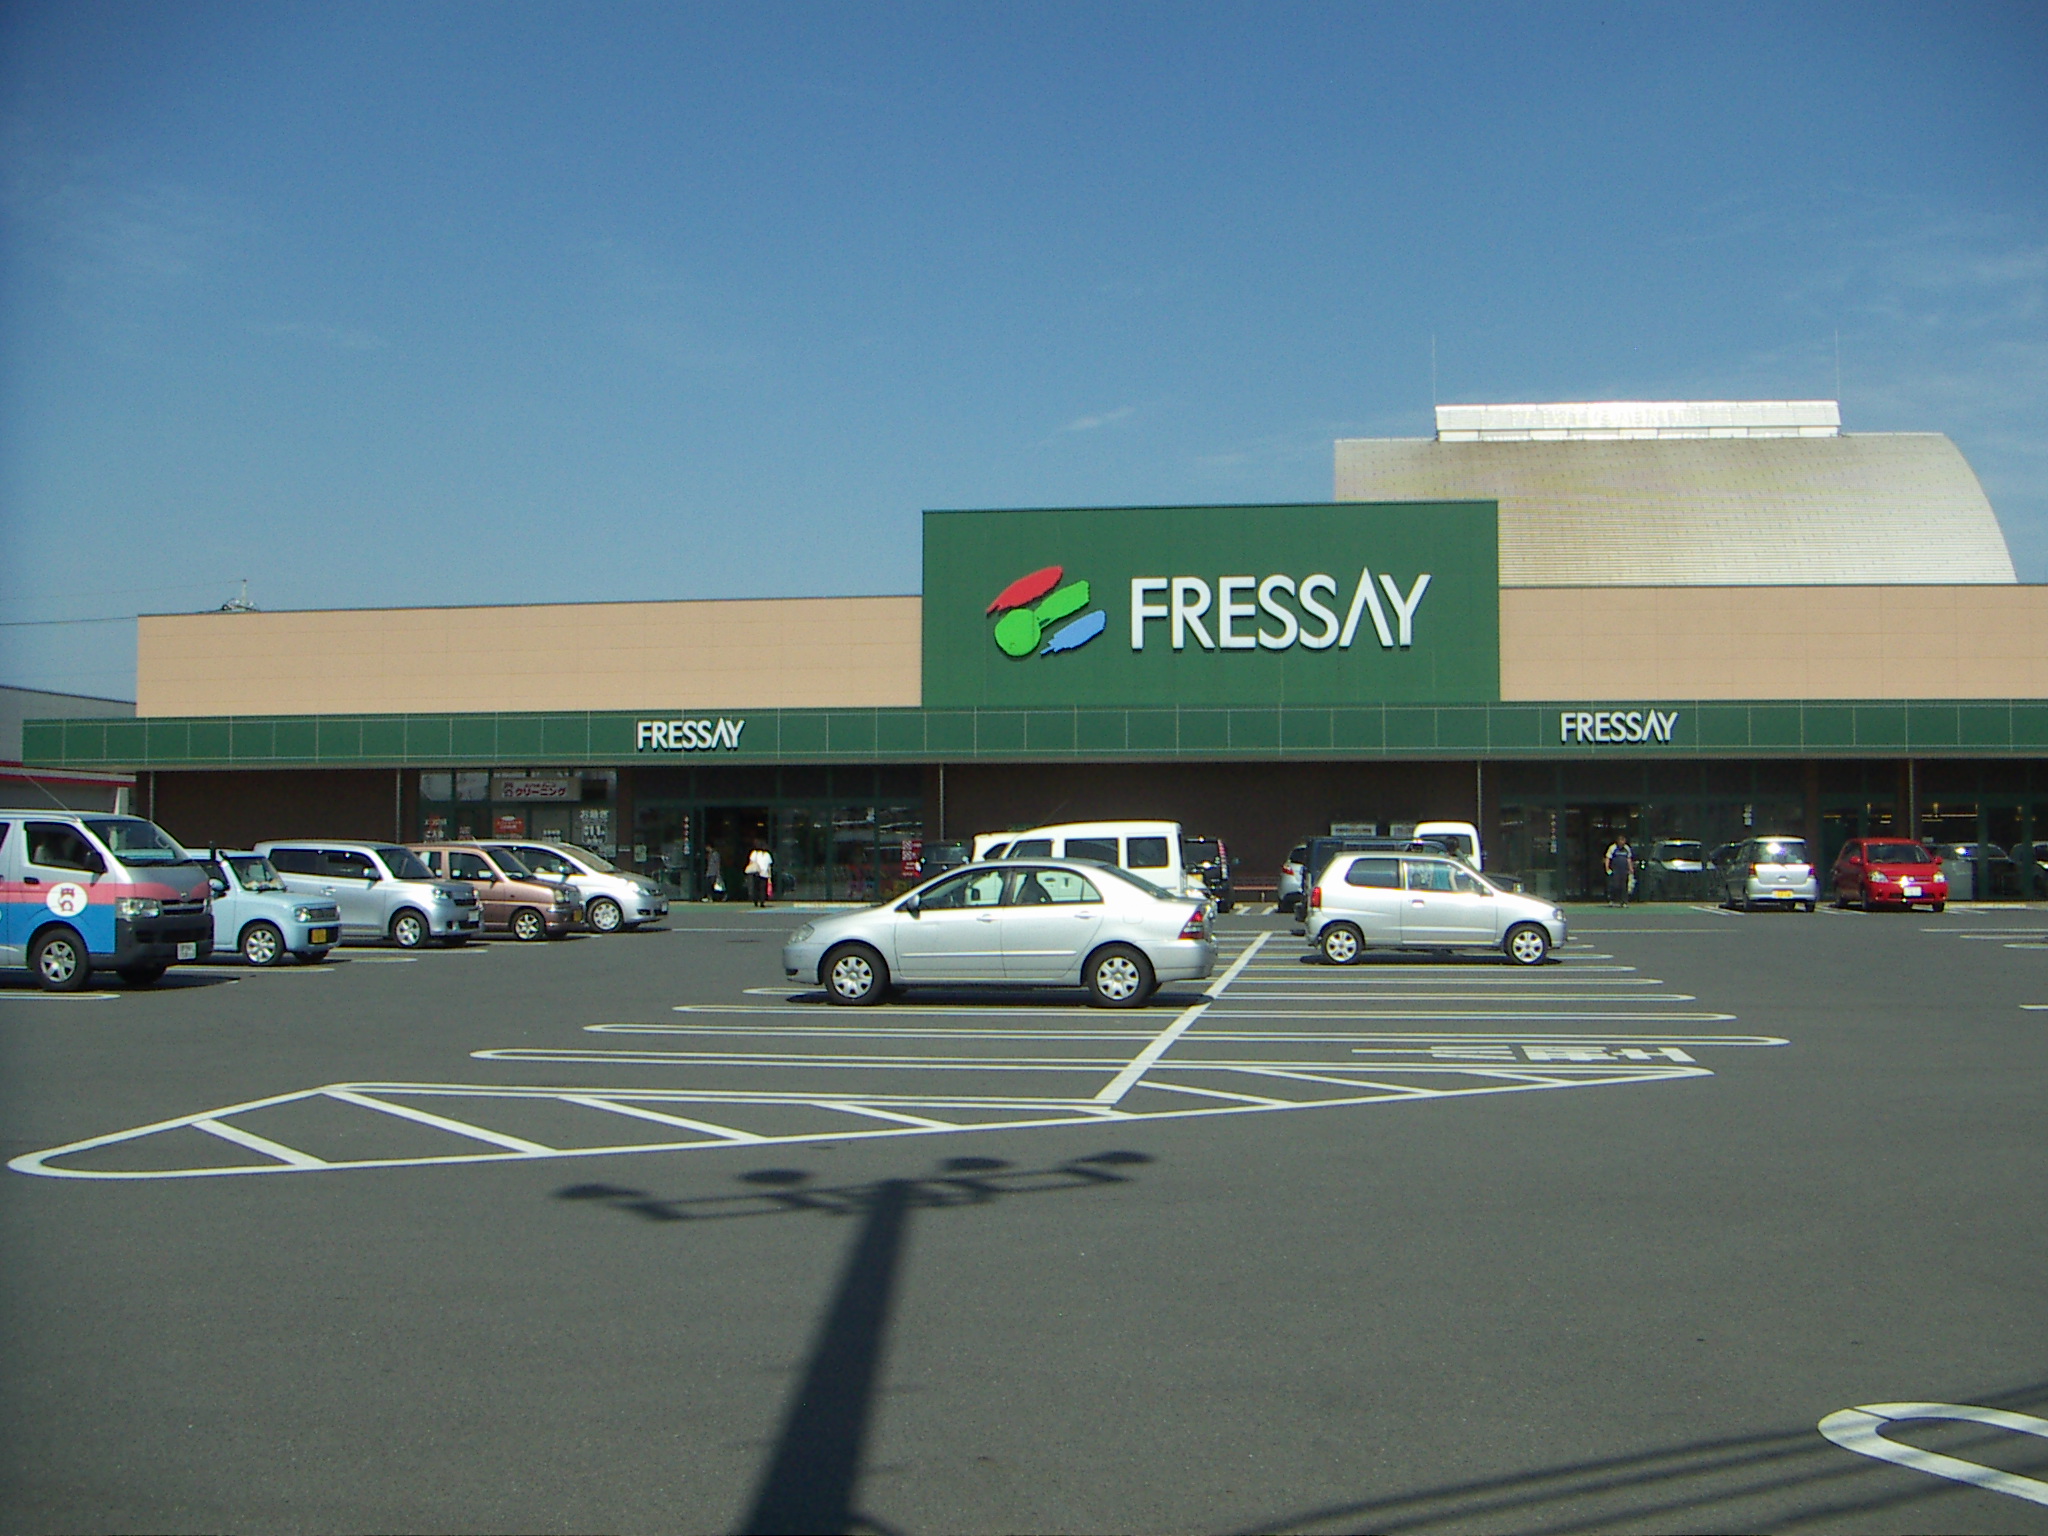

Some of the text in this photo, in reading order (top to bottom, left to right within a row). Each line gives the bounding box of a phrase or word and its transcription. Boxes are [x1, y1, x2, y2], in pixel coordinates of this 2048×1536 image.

[1130, 567, 1433, 651] FRESSAY
[636, 718, 746, 751] FRESSAY
[1560, 709, 1679, 743] FRESSAY
[515, 787, 566, 797] クリーニング
